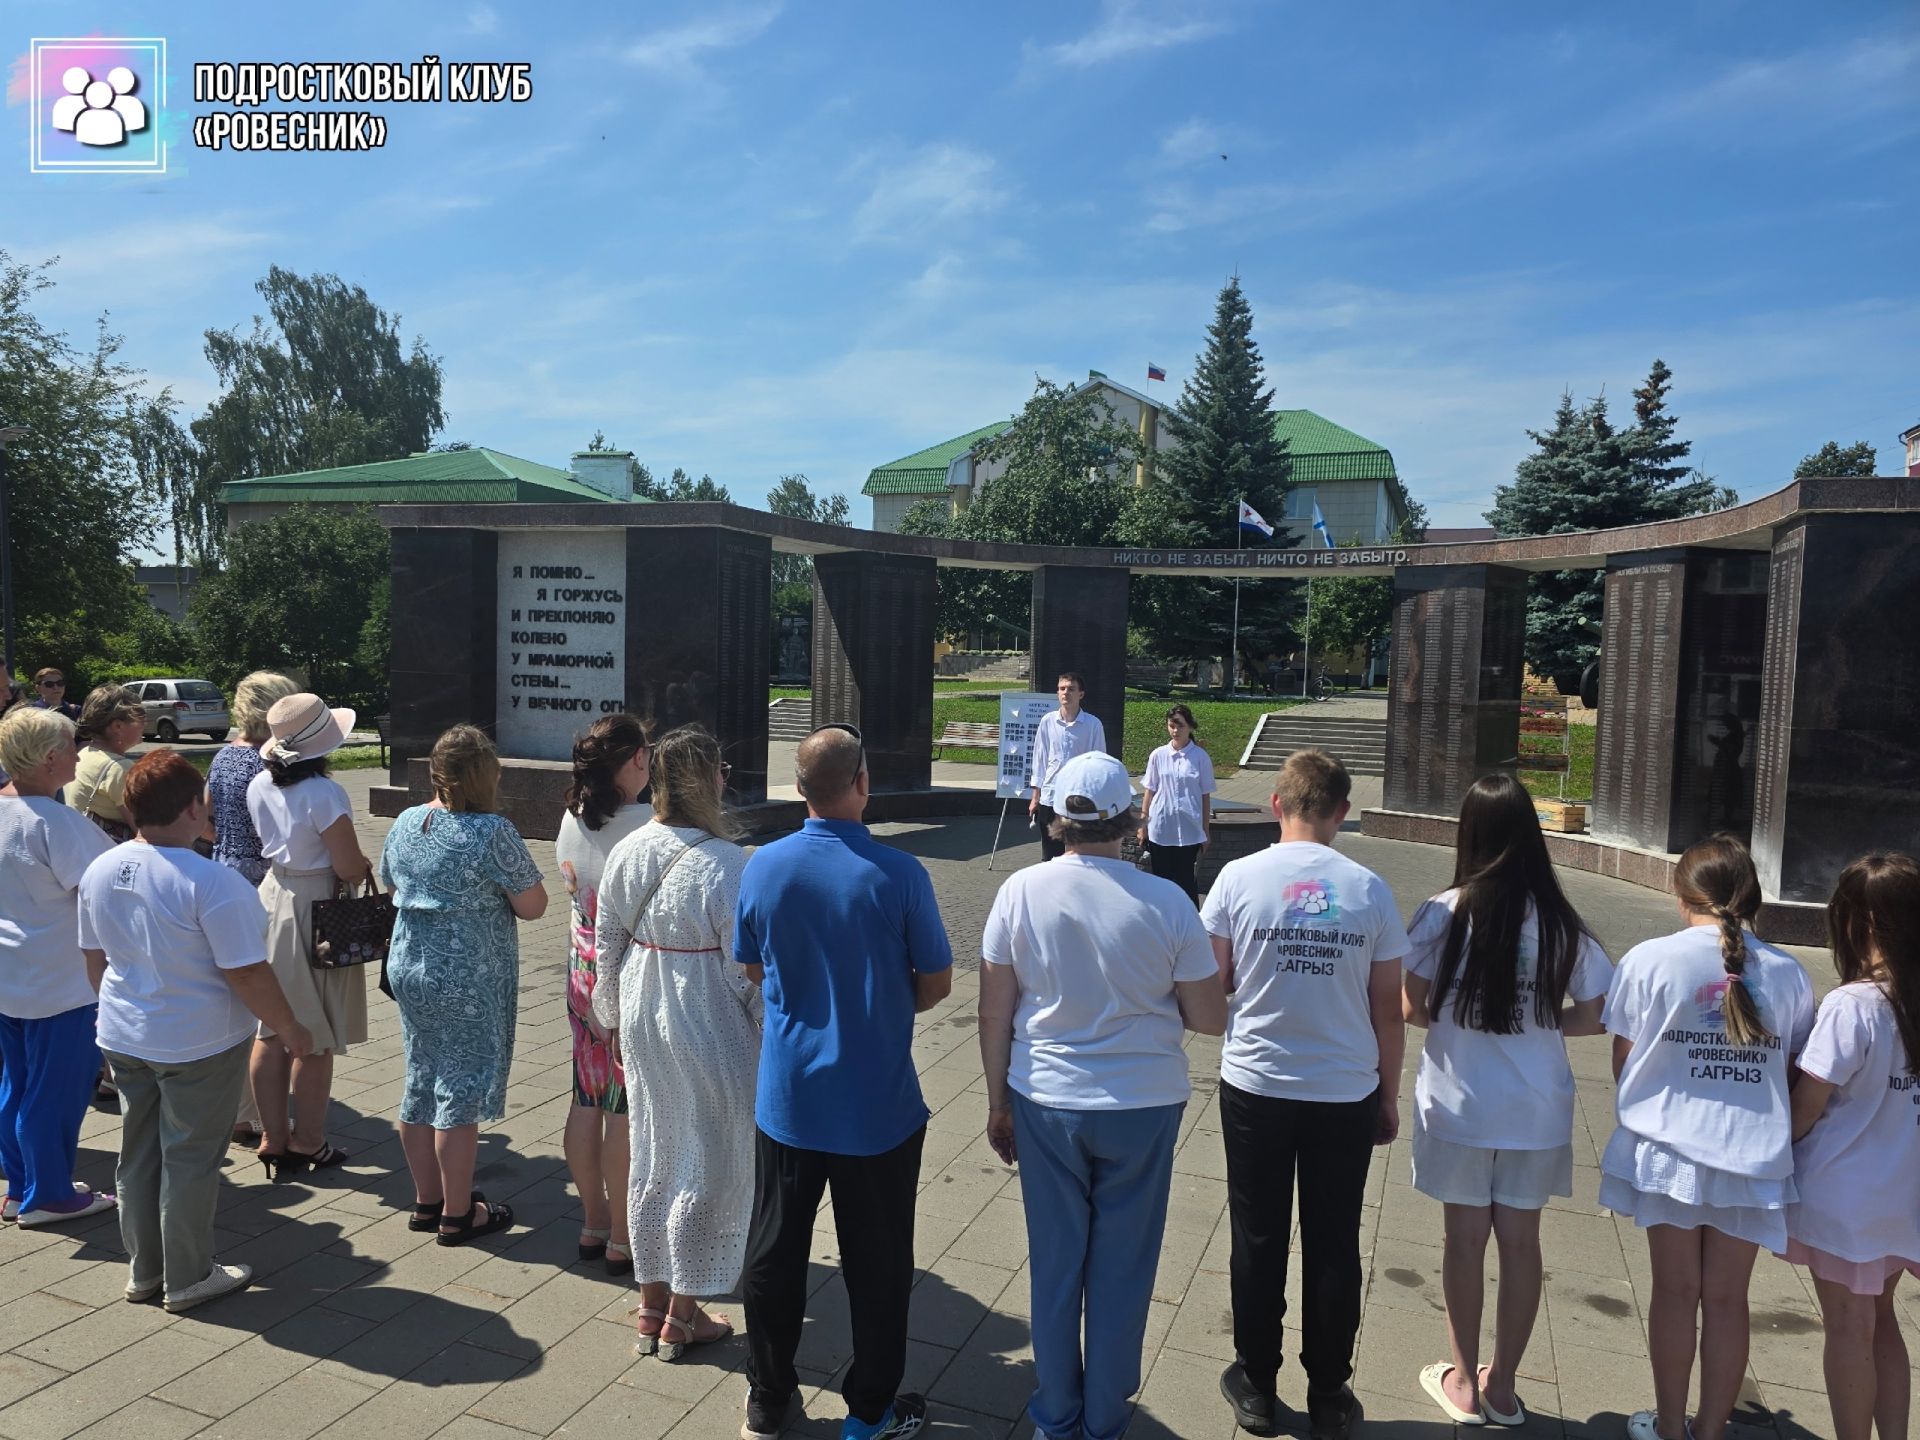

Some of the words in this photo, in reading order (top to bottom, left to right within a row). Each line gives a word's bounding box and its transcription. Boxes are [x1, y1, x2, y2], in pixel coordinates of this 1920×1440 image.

[1113, 553, 1161, 564] НИКТО
[1167, 553, 1186, 565] НЕ
[1193, 553, 1250, 566] ЗАБЫТ,
[1257, 553, 1307, 566] НИЧТО
[1313, 553, 1333, 565] НЕ
[1339, 551, 1410, 564] ЗАБЫТО.
[512, 566, 522, 579] Я
[530, 566, 595, 580] ПОМНЮ...
[536, 588, 547, 601] Я
[554, 588, 623, 603] ГОРЖУСЬ
[511, 609, 521, 622] И
[528, 609, 615, 624] ПРЕКЛОНЯЮ
[511, 631, 567, 645] КОЛЕНО
[511, 652, 520, 665] У
[528, 651, 614, 669] МРАМОРНОЙ
[511, 674, 571, 689] СТЕНЫ...
[511, 695, 520, 708] У
[528, 696, 592, 712] ВЕЧНОГО
[1253, 928, 1339, 945] ПОДРОСТКОВЫЙ
[1341, 932, 1366, 948] КЛУБ
[1277, 944, 1343, 959] «РОВЕСНИК»
[1276, 959, 1335, 976] г.АГРЫЗ
[1688, 1048, 1767, 1064] «РОВЕСНИК»
[1690, 1065, 1762, 1084] г.АГРЫЗ
